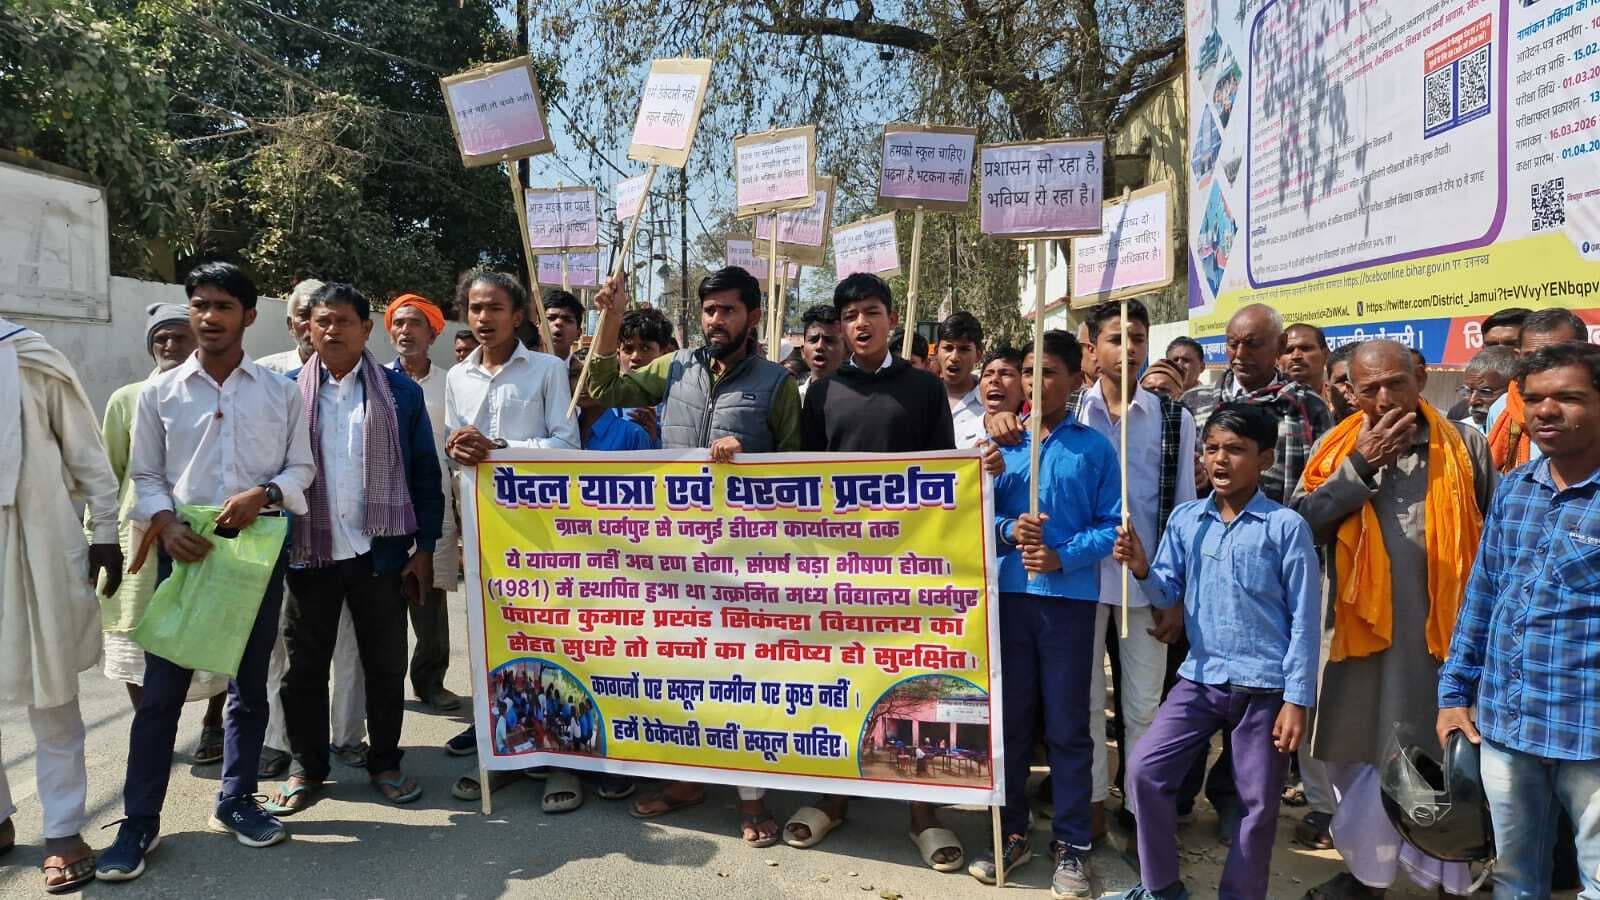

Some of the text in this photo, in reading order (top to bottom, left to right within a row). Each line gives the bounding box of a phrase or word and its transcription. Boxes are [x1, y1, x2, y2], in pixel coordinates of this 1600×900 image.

[1517, 19, 1545, 40] नामांकन
[1547, 7, 1574, 27] प्रक्रिया
[1556, 25, 1582, 44] समर्पण
[1516, 91, 1536, 106] परीक्षा
[1538, 81, 1555, 98] तिथि
[1516, 108, 1550, 128] परीक्षाफल
[1552, 97, 1580, 116] प्रकाशन
[1549, 115, 1597, 140] 16.03.2026
[889, 140, 967, 162] हमको स्कूल चाहिए।
[984, 150, 1099, 176] प्रशासन सो रहा है,
[1516, 160, 1532, 171] कक्षा
[988, 182, 1095, 208] भविष्य रो रहा है।
[493, 465, 957, 511] पैदल यात्रा एवं धरना प्रदर्शन
[555, 516, 900, 544] ग्राम धर्मपुर से जमुई डीएम कार्यालय तक
[506, 548, 521, 569] ये
[526, 552, 581, 569] याचना
[586, 549, 621, 570] नहीं
[626, 553, 654, 571] अब
[660, 554, 686, 572] रण
[692, 551, 738, 576] होगा,
[746, 552, 791, 574] संघर्ष
[796, 556, 829, 579] बड़ा
[836, 552, 892, 575] भीषण
[487, 577, 978, 613] (1981) में स्थापित हुआ था उत्क्रमित मध्य विद्यालय धर्मपुर
[501, 603, 964, 636] पंचायत कुमार प्रखंड सिकंदरा विद्यालय का
[507, 631, 555, 653] सेहत
[562, 636, 617, 661] सुधरे
[624, 636, 648, 657] तो
[656, 637, 708, 659] बच्चों
[715, 642, 746, 661] का
[754, 640, 832, 662] भविष्य
[840, 642, 865, 664] हो
[590, 671, 639, 699] कागजों
[643, 678, 662, 700] पर
[667, 679, 704, 710] स्कूल
[709, 675, 756, 704] जमीन
[761, 682, 781, 705] पर
[785, 683, 814, 715] कुछ
[612, 717, 848, 762] हमें ठेकेदारी नहीं स्कूल चाहिए।
